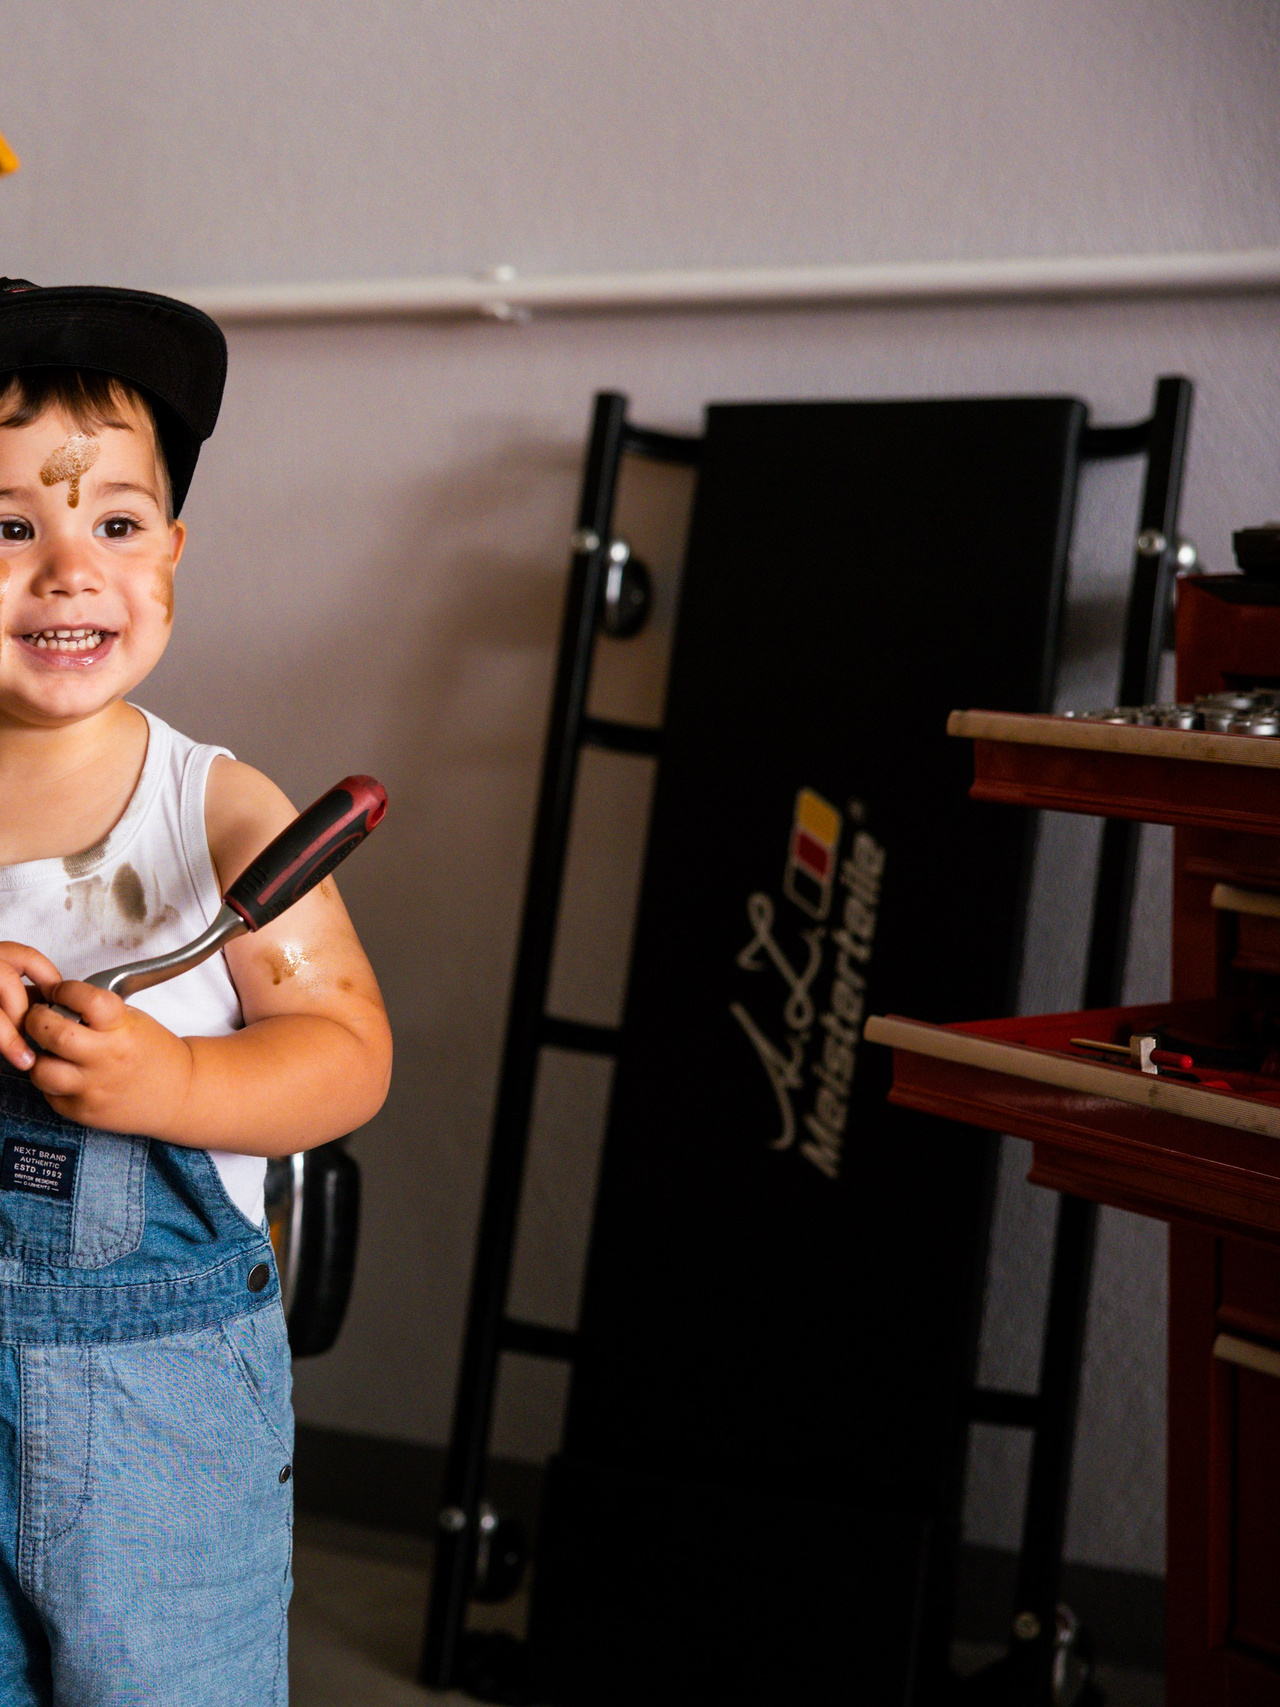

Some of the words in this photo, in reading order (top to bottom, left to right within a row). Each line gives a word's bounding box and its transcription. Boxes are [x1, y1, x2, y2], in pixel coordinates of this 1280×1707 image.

[799, 831, 886, 1180] Meisterteile
[14, 1146, 36, 1155] NEXT
[39, 1151, 66, 1162] BRAND
[20, 1156, 60, 1169] AUTHENTIC
[14, 1163, 39, 1174] ESTD.
[42, 1169, 62, 1178] 1982
[14, 1173, 34, 1181] BRITISH
